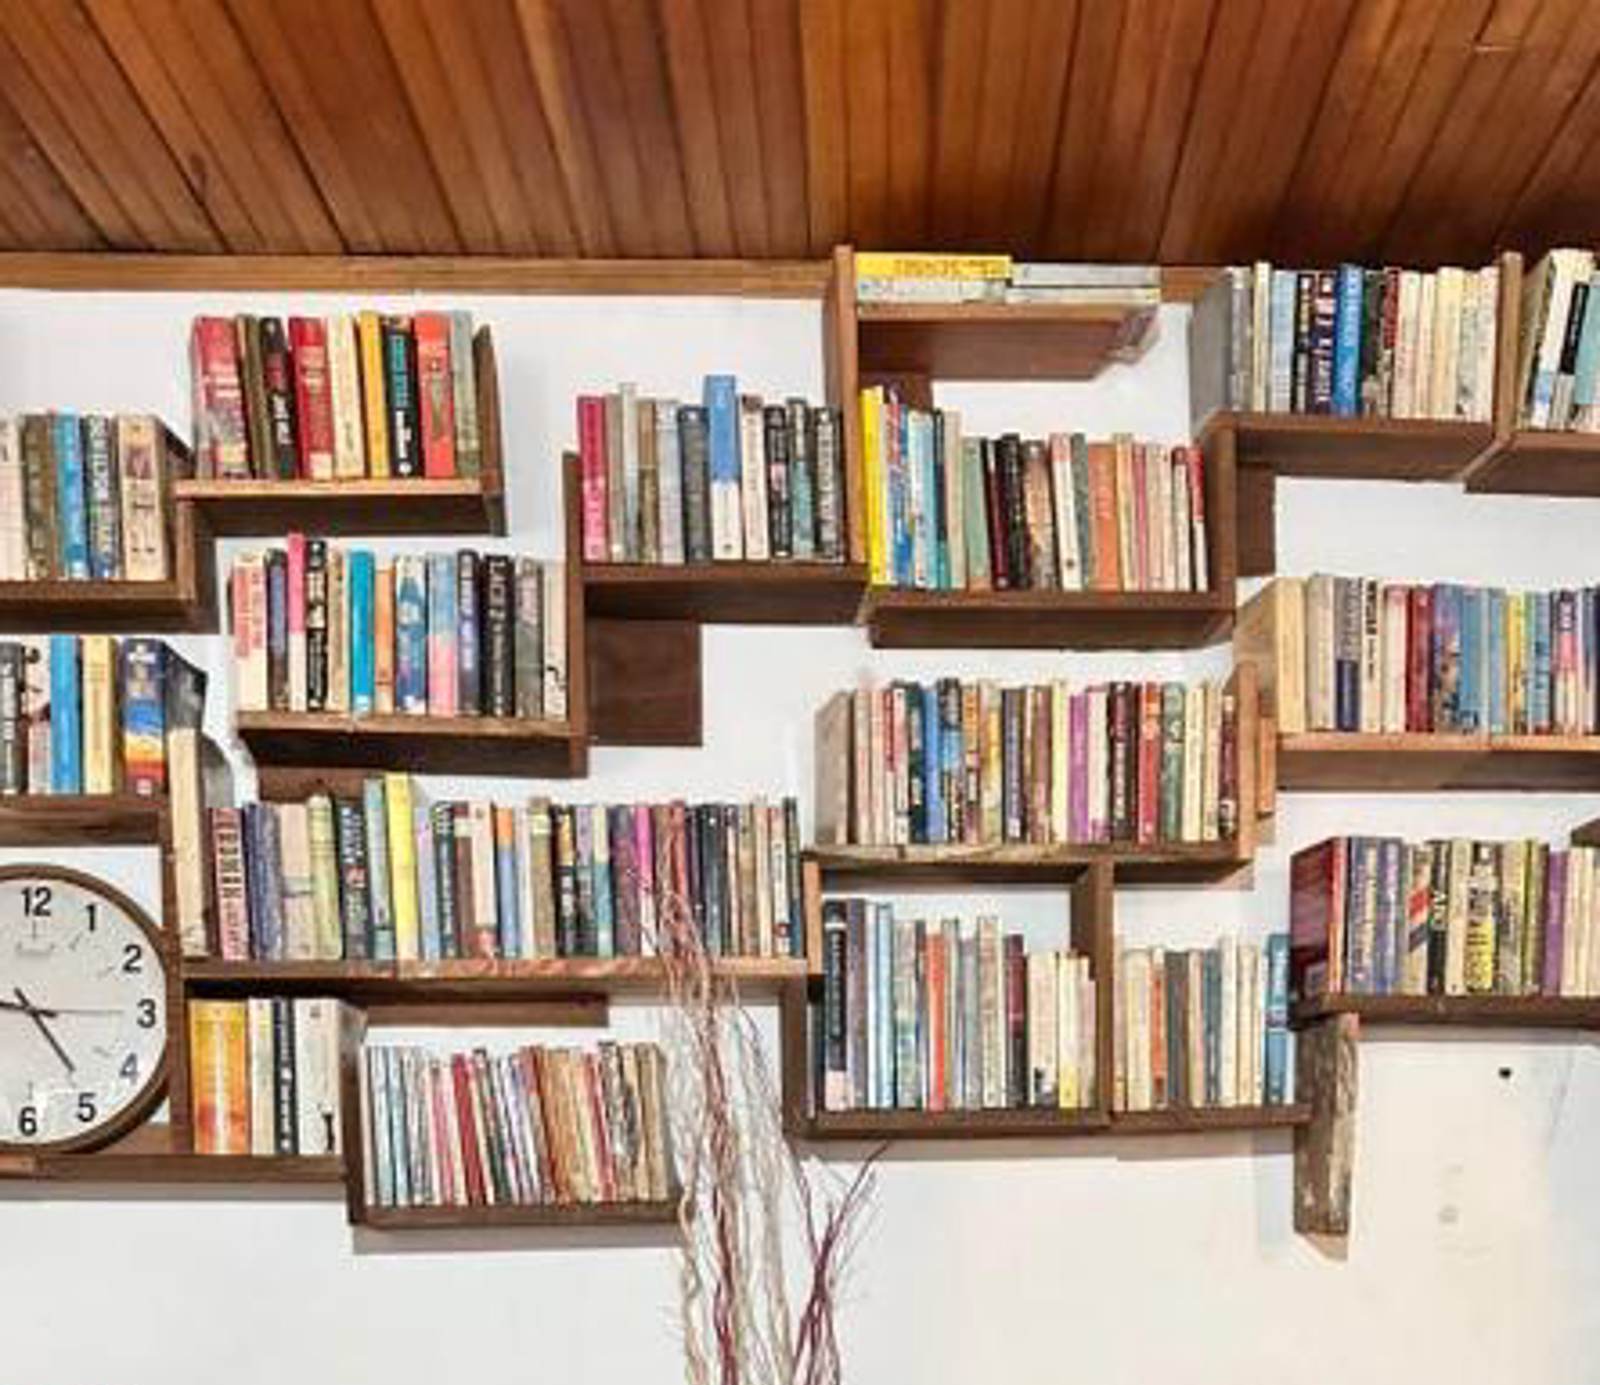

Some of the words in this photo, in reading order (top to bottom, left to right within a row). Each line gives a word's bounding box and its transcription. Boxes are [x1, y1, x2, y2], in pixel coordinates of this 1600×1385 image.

[21, 887, 51, 917] 12
[86, 904, 96, 931] 1
[123, 944, 141, 973] 2
[137, 999, 156, 1028] 3
[119, 1053, 138, 1083] 4
[19, 1107, 37, 1136] 6
[77, 1093, 97, 1122] 5
